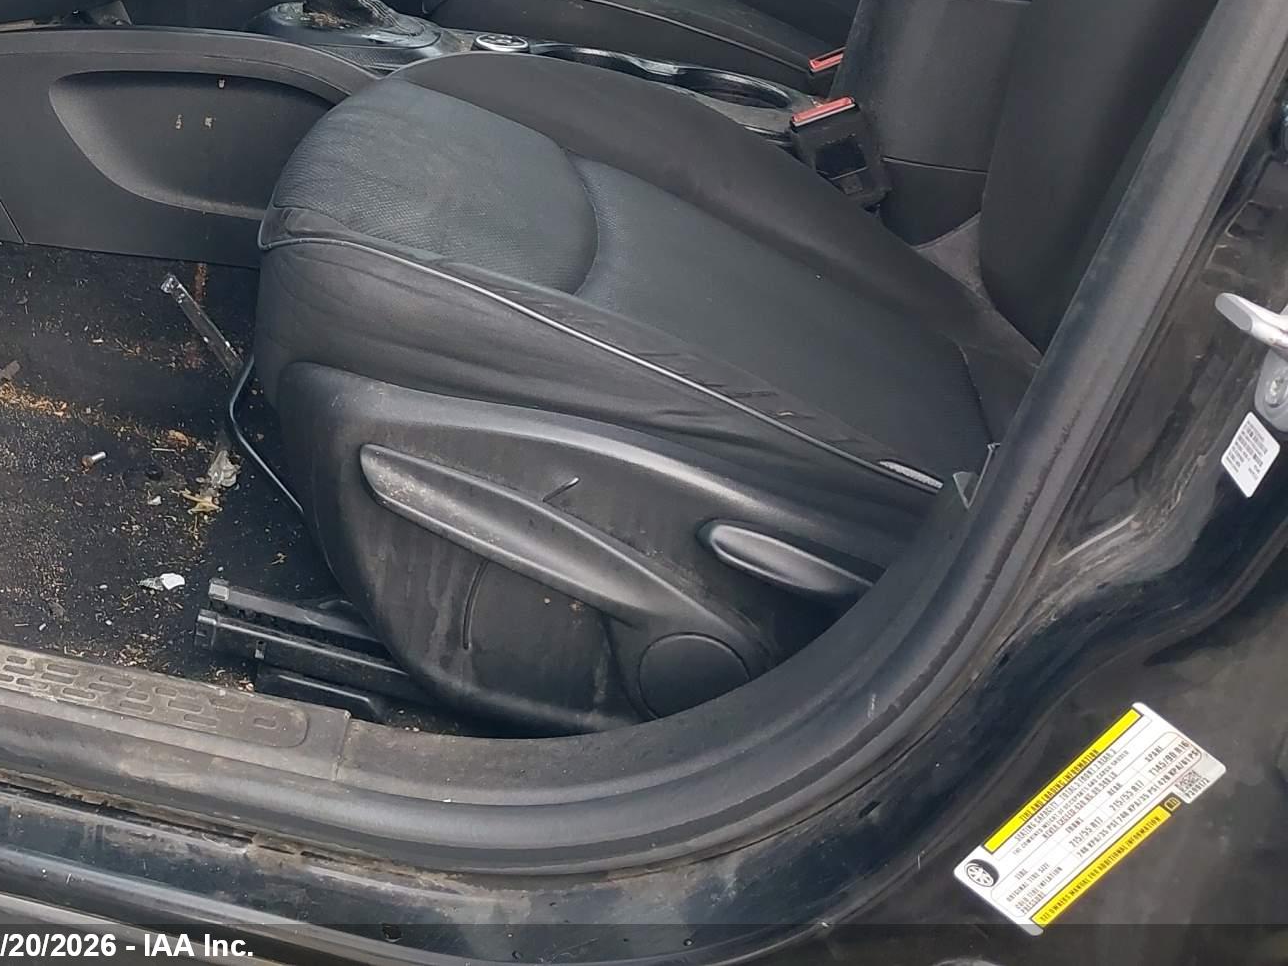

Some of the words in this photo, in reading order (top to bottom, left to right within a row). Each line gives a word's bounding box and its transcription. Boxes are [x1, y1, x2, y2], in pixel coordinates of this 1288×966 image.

[1061, 747, 1100, 782] INFORMATION
[1013, 821, 1036, 842] SEATING
[1032, 800, 1060, 824] CAPACITY
[1058, 784, 1077, 801] TOTAL
[1122, 814, 1161, 847] INFORMATION
